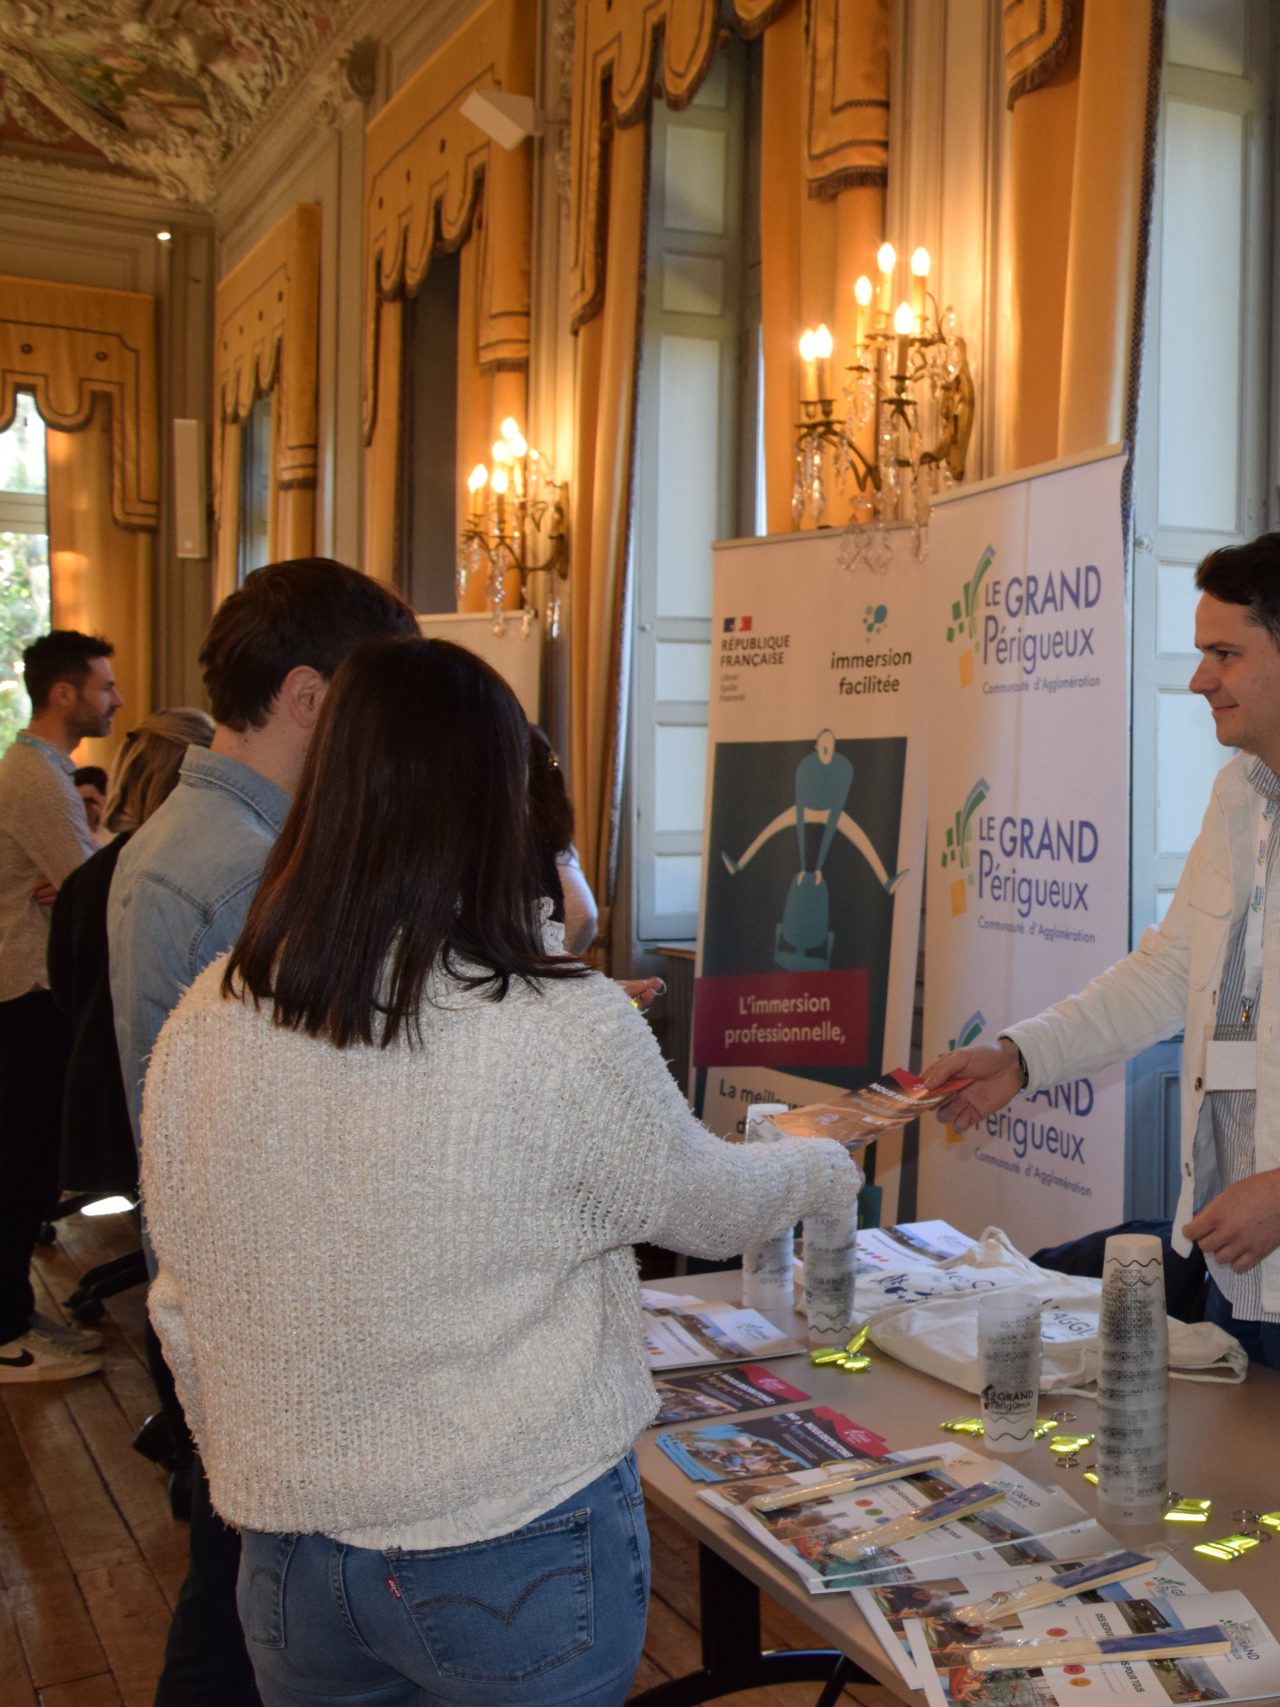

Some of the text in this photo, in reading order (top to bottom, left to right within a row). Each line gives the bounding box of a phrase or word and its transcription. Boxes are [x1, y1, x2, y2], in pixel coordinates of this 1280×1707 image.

[985, 565, 1102, 618] LE GRAND
[721, 635, 791, 651] RÉPUBLIQUE
[983, 614, 1095, 675] Périgueux
[720, 652, 785, 668] FRANÇAISE
[831, 648, 912, 669] immersion
[839, 674, 900, 695] facilitée
[979, 816, 1099, 864] LE GRAND
[979, 849, 1089, 918] Périgueux
[739, 992, 830, 1015] L'immersion
[725, 1021, 846, 1049] professionnelle,
[719, 1078, 737, 1099] La
